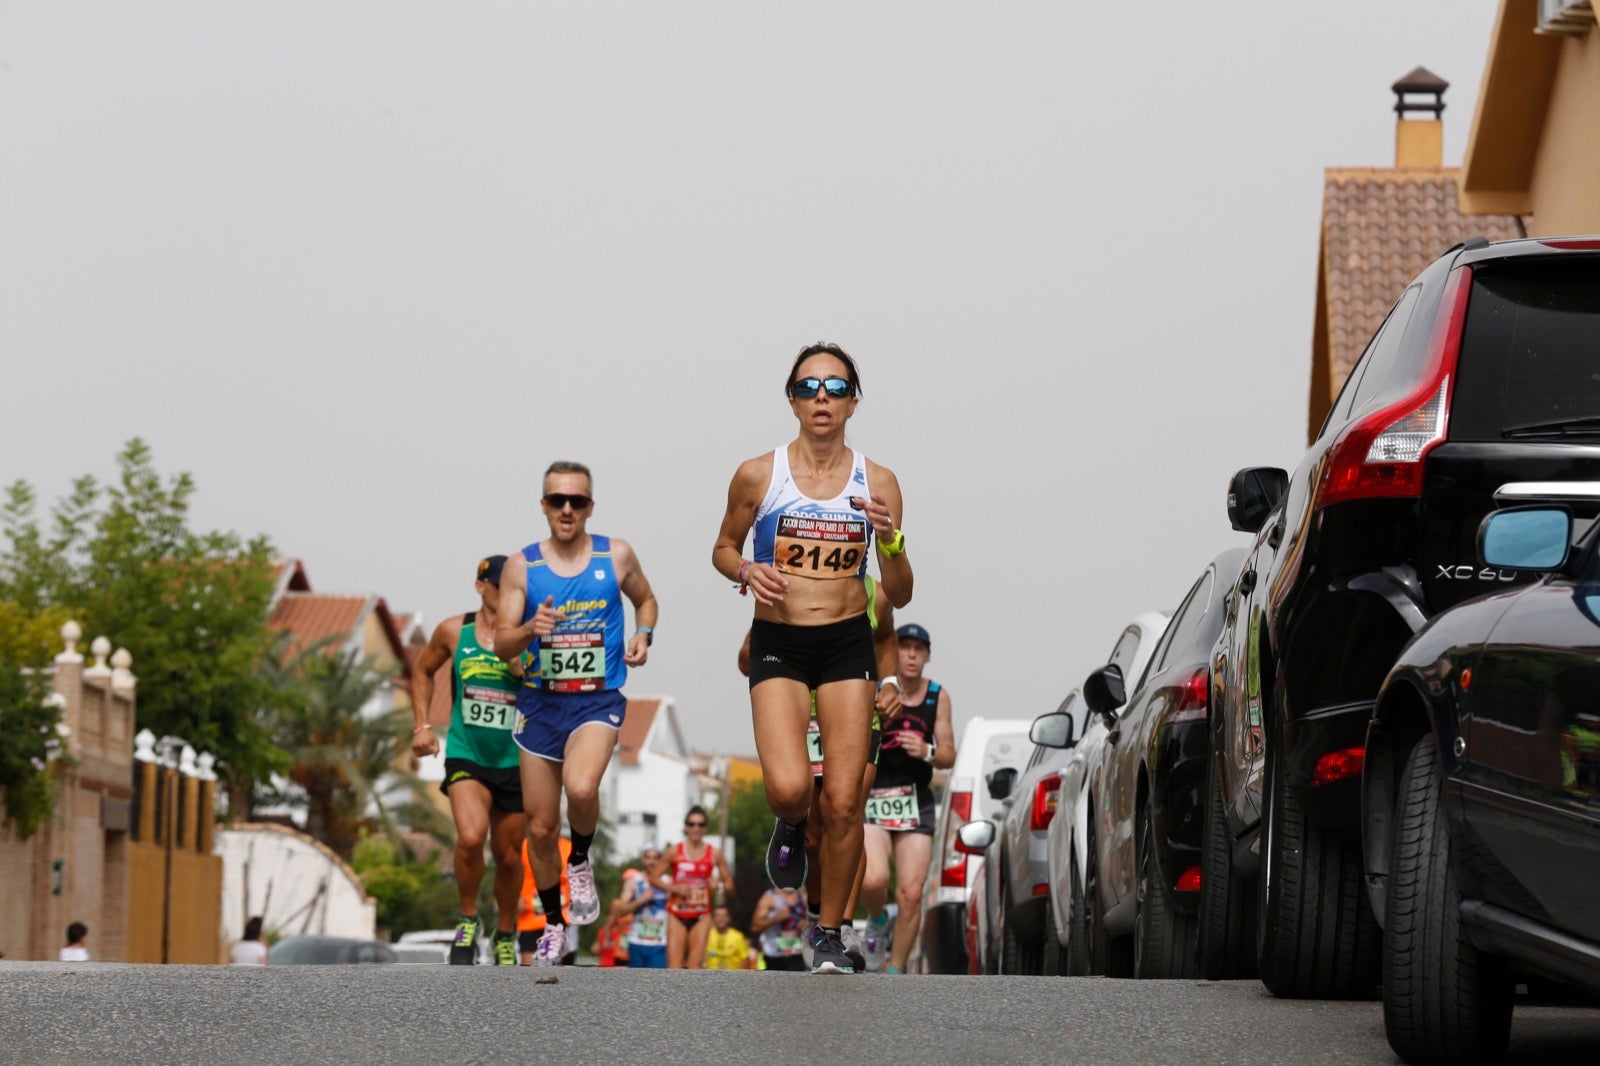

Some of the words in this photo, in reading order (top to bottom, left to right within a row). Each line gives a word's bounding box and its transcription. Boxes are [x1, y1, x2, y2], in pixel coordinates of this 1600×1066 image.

[785, 510, 818, 519] TODO
[821, 512, 854, 521] SUMA
[798, 519, 814, 530] GRAN
[815, 520, 837, 532] PREMIO
[837, 523, 845, 532] DE
[845, 523, 861, 533] FONDO
[787, 544, 859, 572] 2149
[551, 651, 595, 674] 542
[470, 703, 507, 725] 951
[869, 798, 913, 817] 1091
